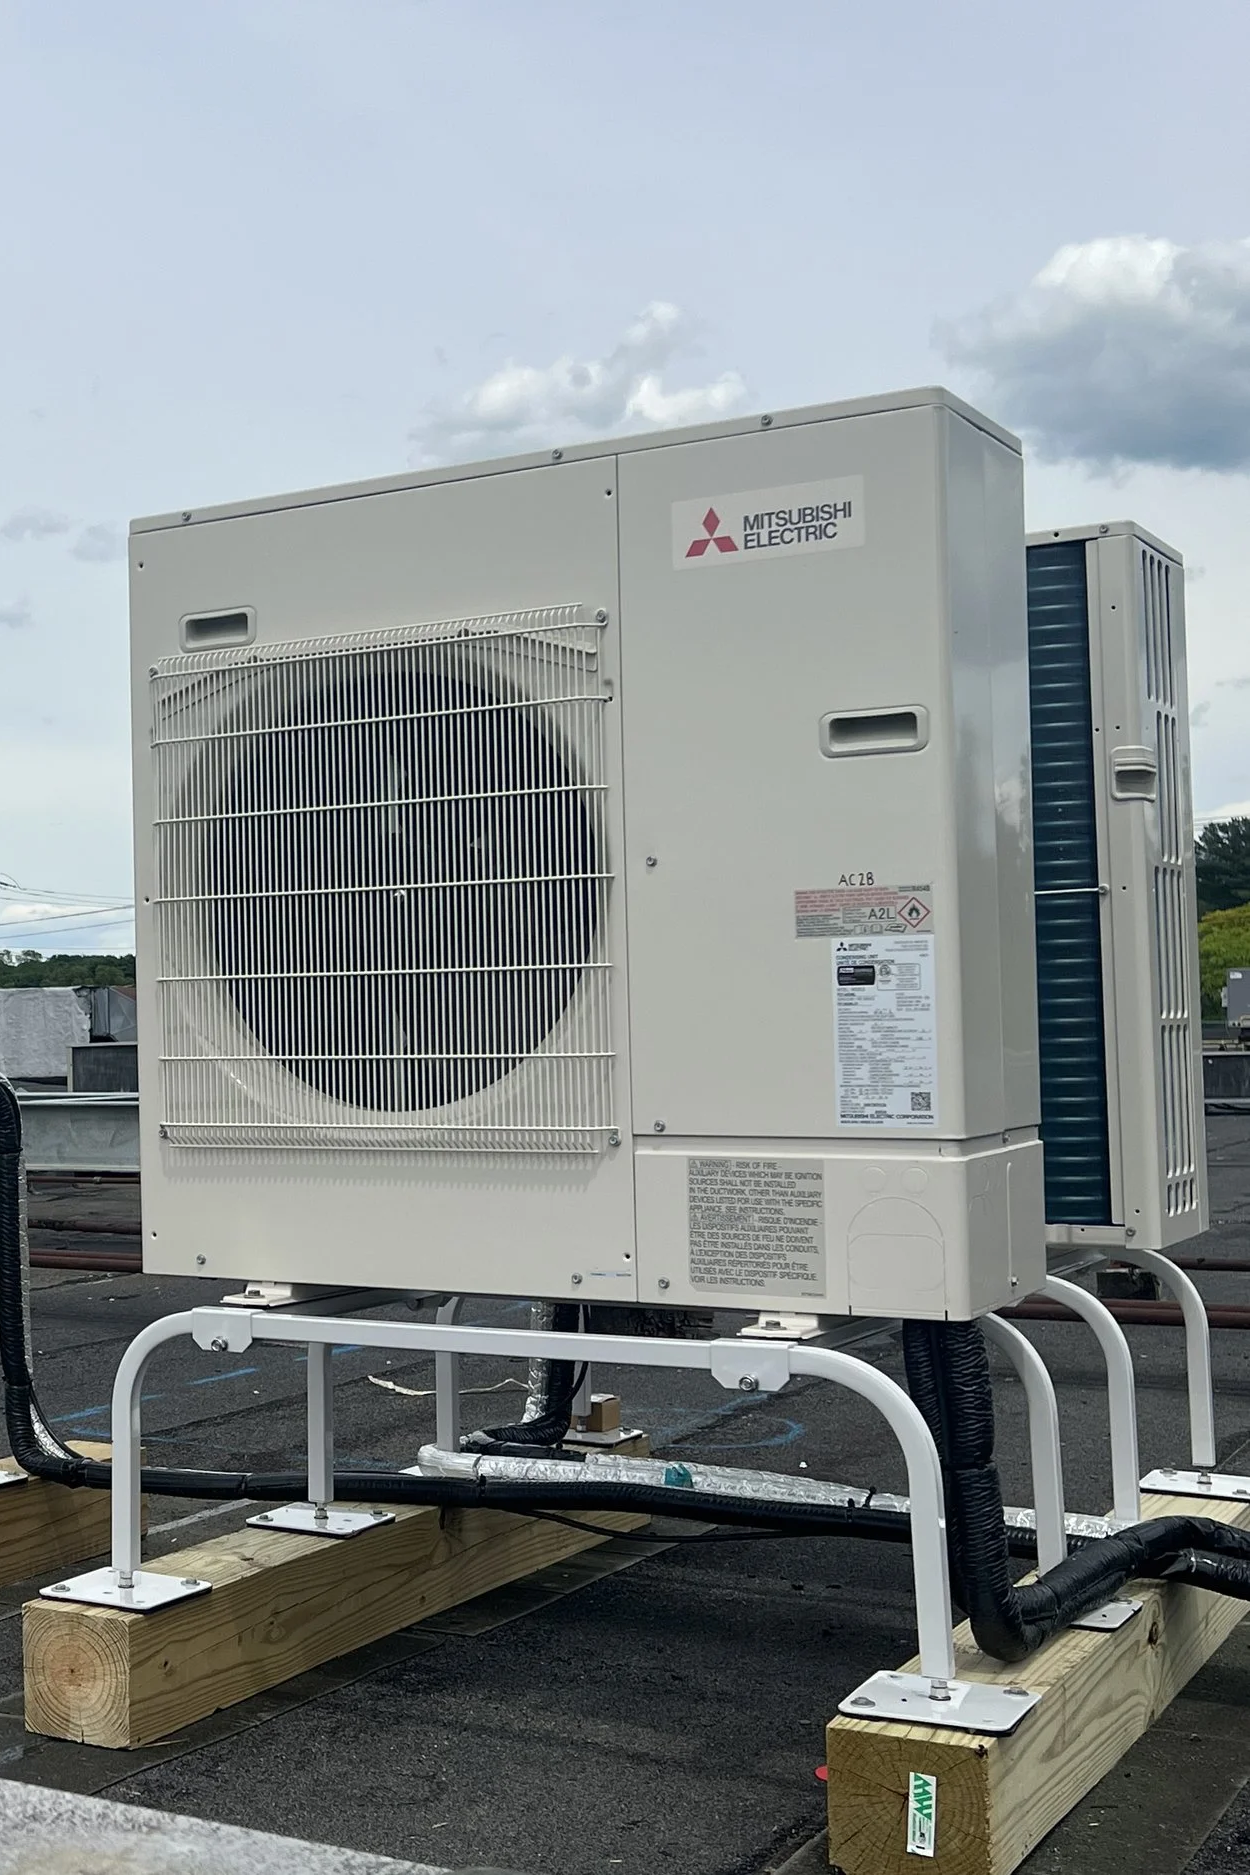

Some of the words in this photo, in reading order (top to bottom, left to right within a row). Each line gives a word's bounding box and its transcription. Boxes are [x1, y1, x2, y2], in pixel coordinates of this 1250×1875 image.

[743, 501, 852, 532] MITSUBISHI
[744, 522, 837, 550] ELECTRIC
[868, 908, 895, 920] A2L
[690, 1196, 714, 1204] DEVICES
[702, 1223, 738, 1231] DISPOSITIFS
[721, 1233, 750, 1241] SOURCES
[754, 1243, 770, 1251] DANS
[772, 1262, 790, 1270] POUR
